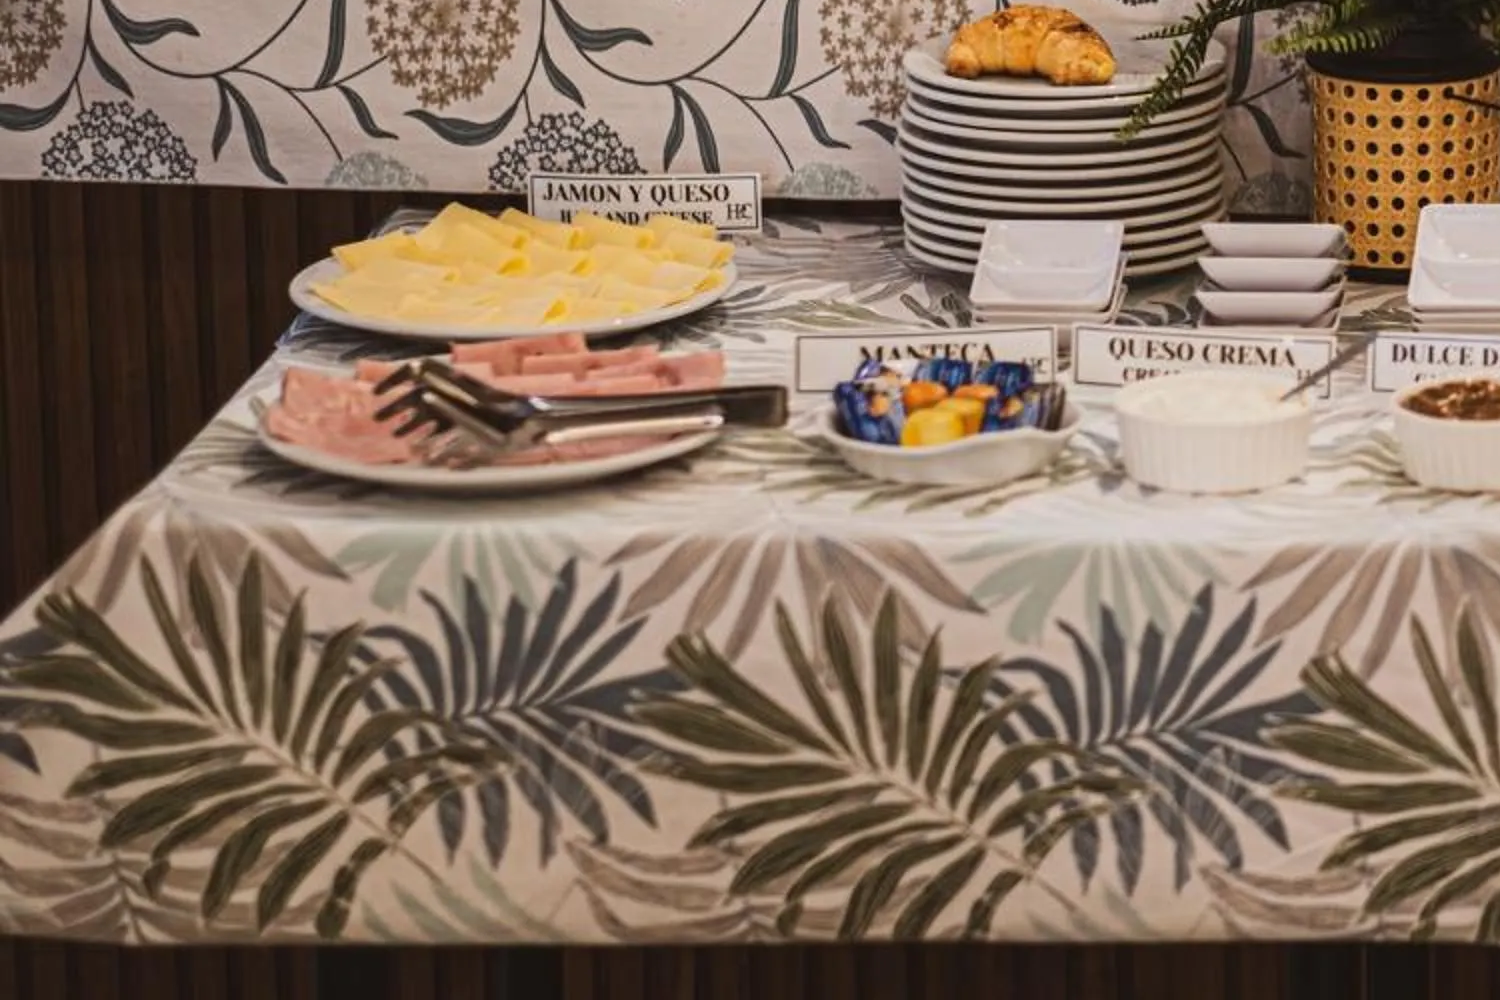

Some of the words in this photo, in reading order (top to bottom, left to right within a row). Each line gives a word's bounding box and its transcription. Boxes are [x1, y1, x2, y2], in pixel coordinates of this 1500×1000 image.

[543, 184, 627, 202] JAMON
[630, 184, 643, 202] Y
[651, 184, 729, 206] QUESO
[1108, 336, 1194, 362] QUESO
[1202, 343, 1296, 367] CREMA
[1391, 343, 1474, 367] DULCE
